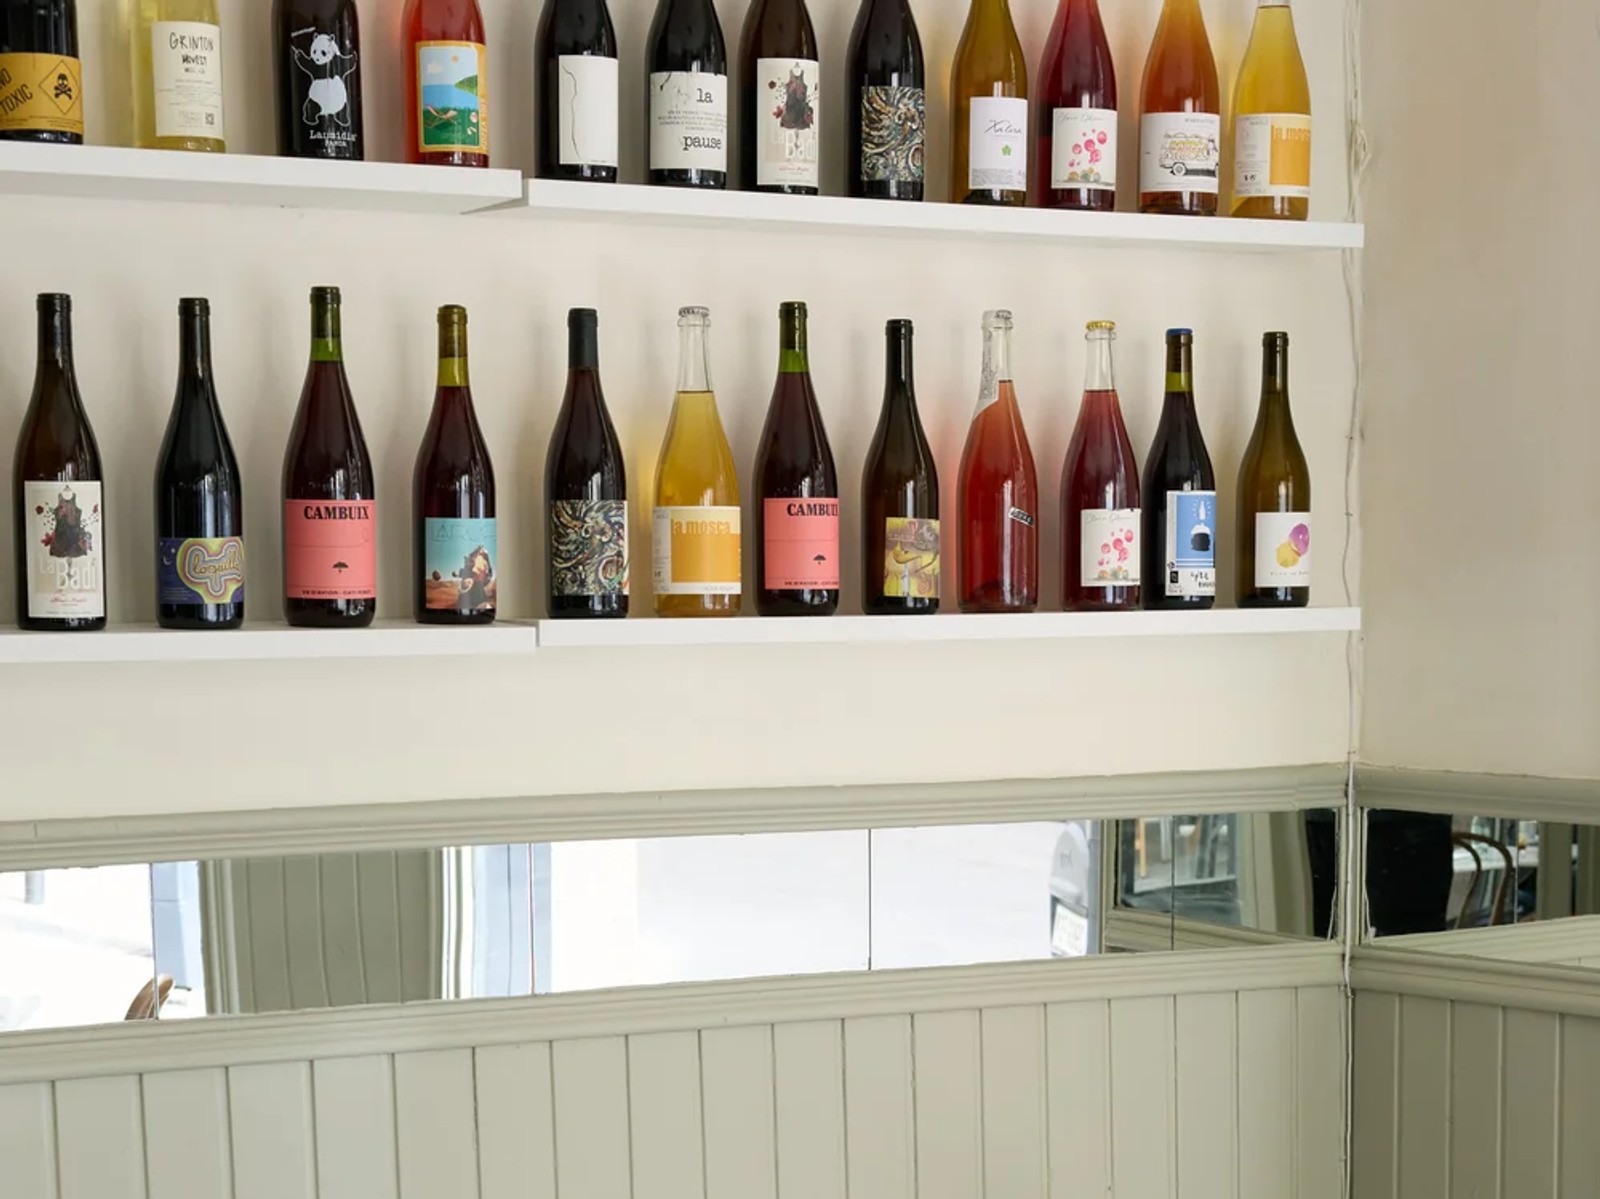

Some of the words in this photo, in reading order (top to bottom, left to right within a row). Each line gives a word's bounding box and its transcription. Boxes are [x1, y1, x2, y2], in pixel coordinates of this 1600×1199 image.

[0, 84, 34, 115] TOXIC
[696, 88, 713, 103] la
[682, 136, 722, 151] pause
[303, 505, 370, 520] CAMBUIX
[787, 503, 838, 517] CAMBUI
[671, 518, 683, 535] la
[685, 519, 732, 535] mosca
